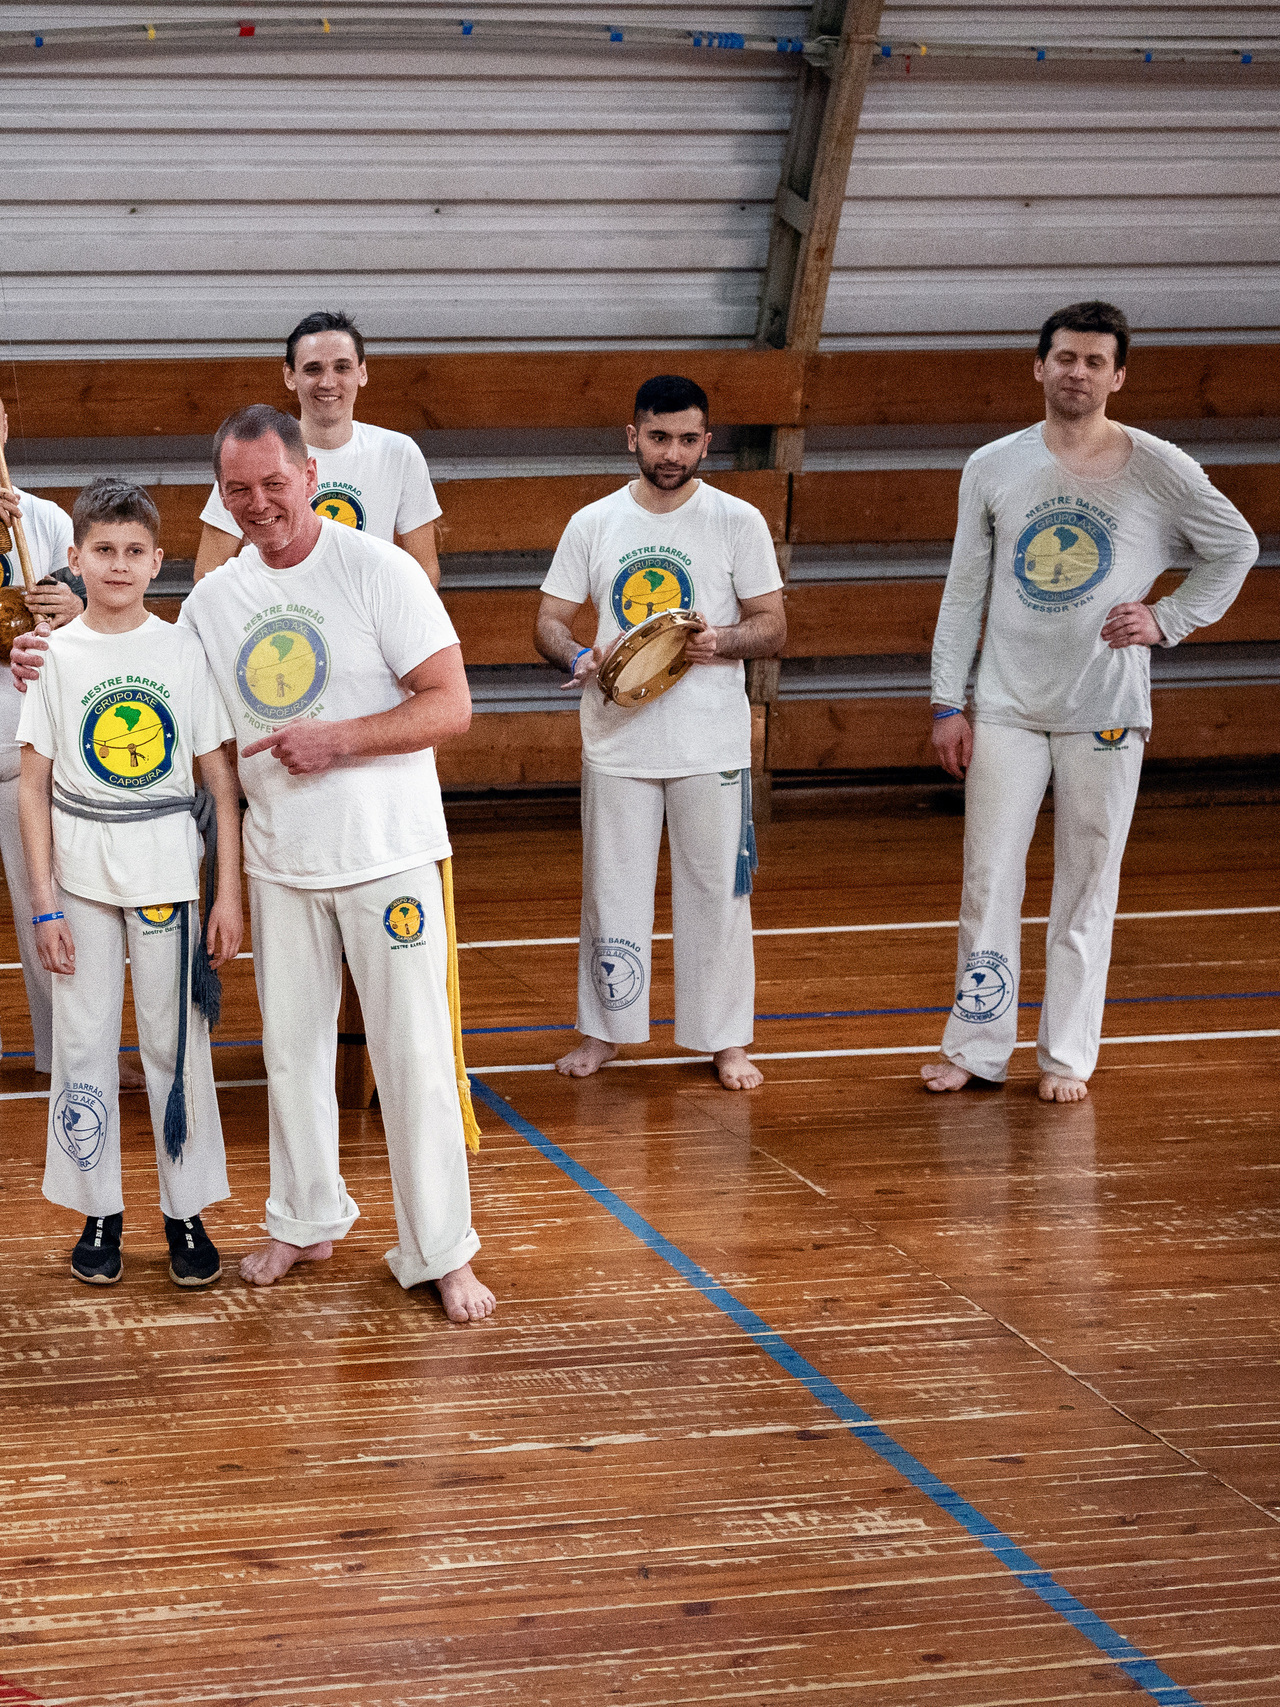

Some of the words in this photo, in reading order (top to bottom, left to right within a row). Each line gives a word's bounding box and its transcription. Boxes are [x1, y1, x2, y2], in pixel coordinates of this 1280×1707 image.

[1025, 495, 1072, 520] MESTRE
[618, 545, 657, 565] MESTRE
[658, 545, 692, 567] BARRÃO
[627, 559, 661, 575] GRUPO
[242, 604, 283, 633] MESTRE
[286, 603, 325, 625] BARRÃO
[253, 620, 290, 642] GRUPO
[80, 676, 123, 706] MESTRE
[126, 675, 171, 699] BARRÃO
[94, 691, 133, 715] GRUPO
[256, 699, 308, 717] CAPOEIRA
[243, 711, 274, 734] PROFE
[109, 768, 164, 787] CAPOEIRA
[608, 937, 641, 954] BARRÃO
[72, 1082, 103, 1098] BARRÃO
